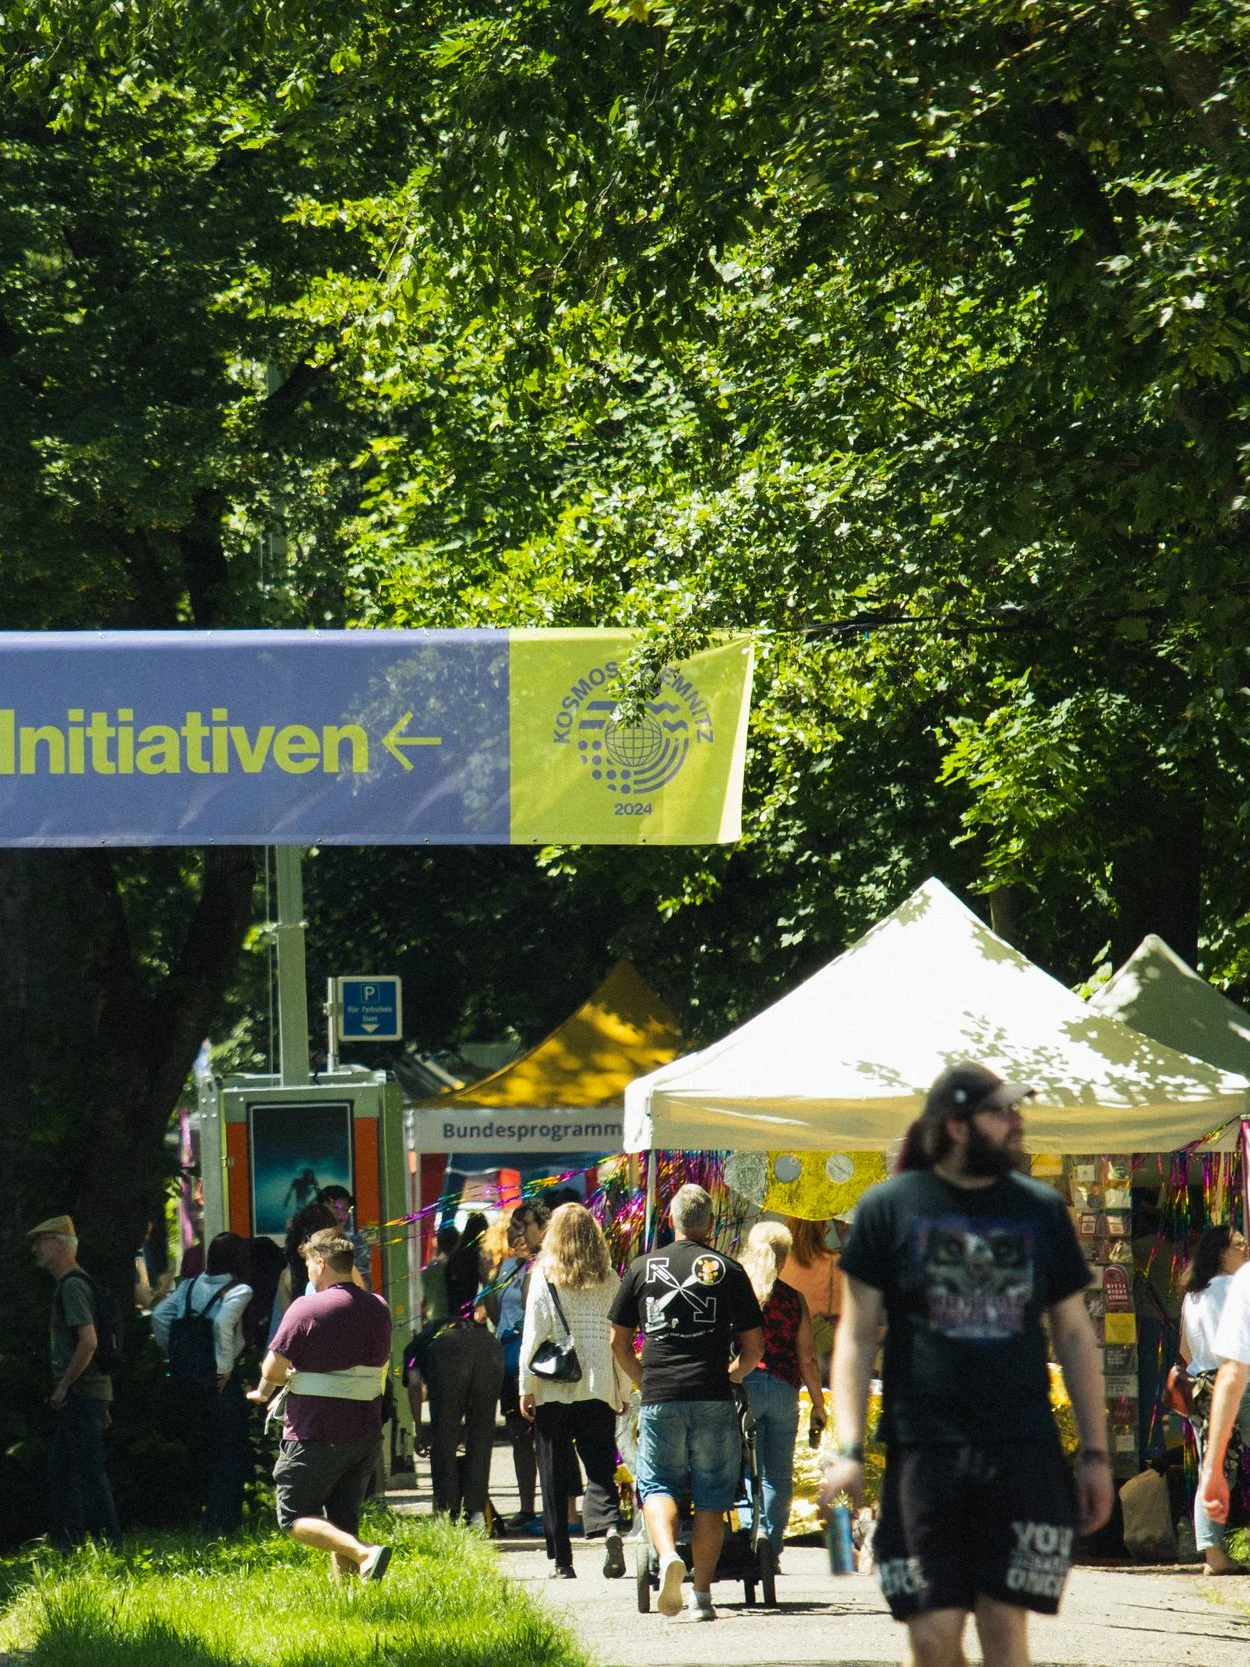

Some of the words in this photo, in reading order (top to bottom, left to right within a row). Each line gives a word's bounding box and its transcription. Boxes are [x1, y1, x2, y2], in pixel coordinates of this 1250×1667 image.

[553, 660, 620, 744] KOSMOS
[628, 662, 714, 744] EMNITZ
[614, 802, 654, 816] 2024
[364, 986, 376, 1001] P
[442, 1121, 623, 1142] Bundesprogramm
